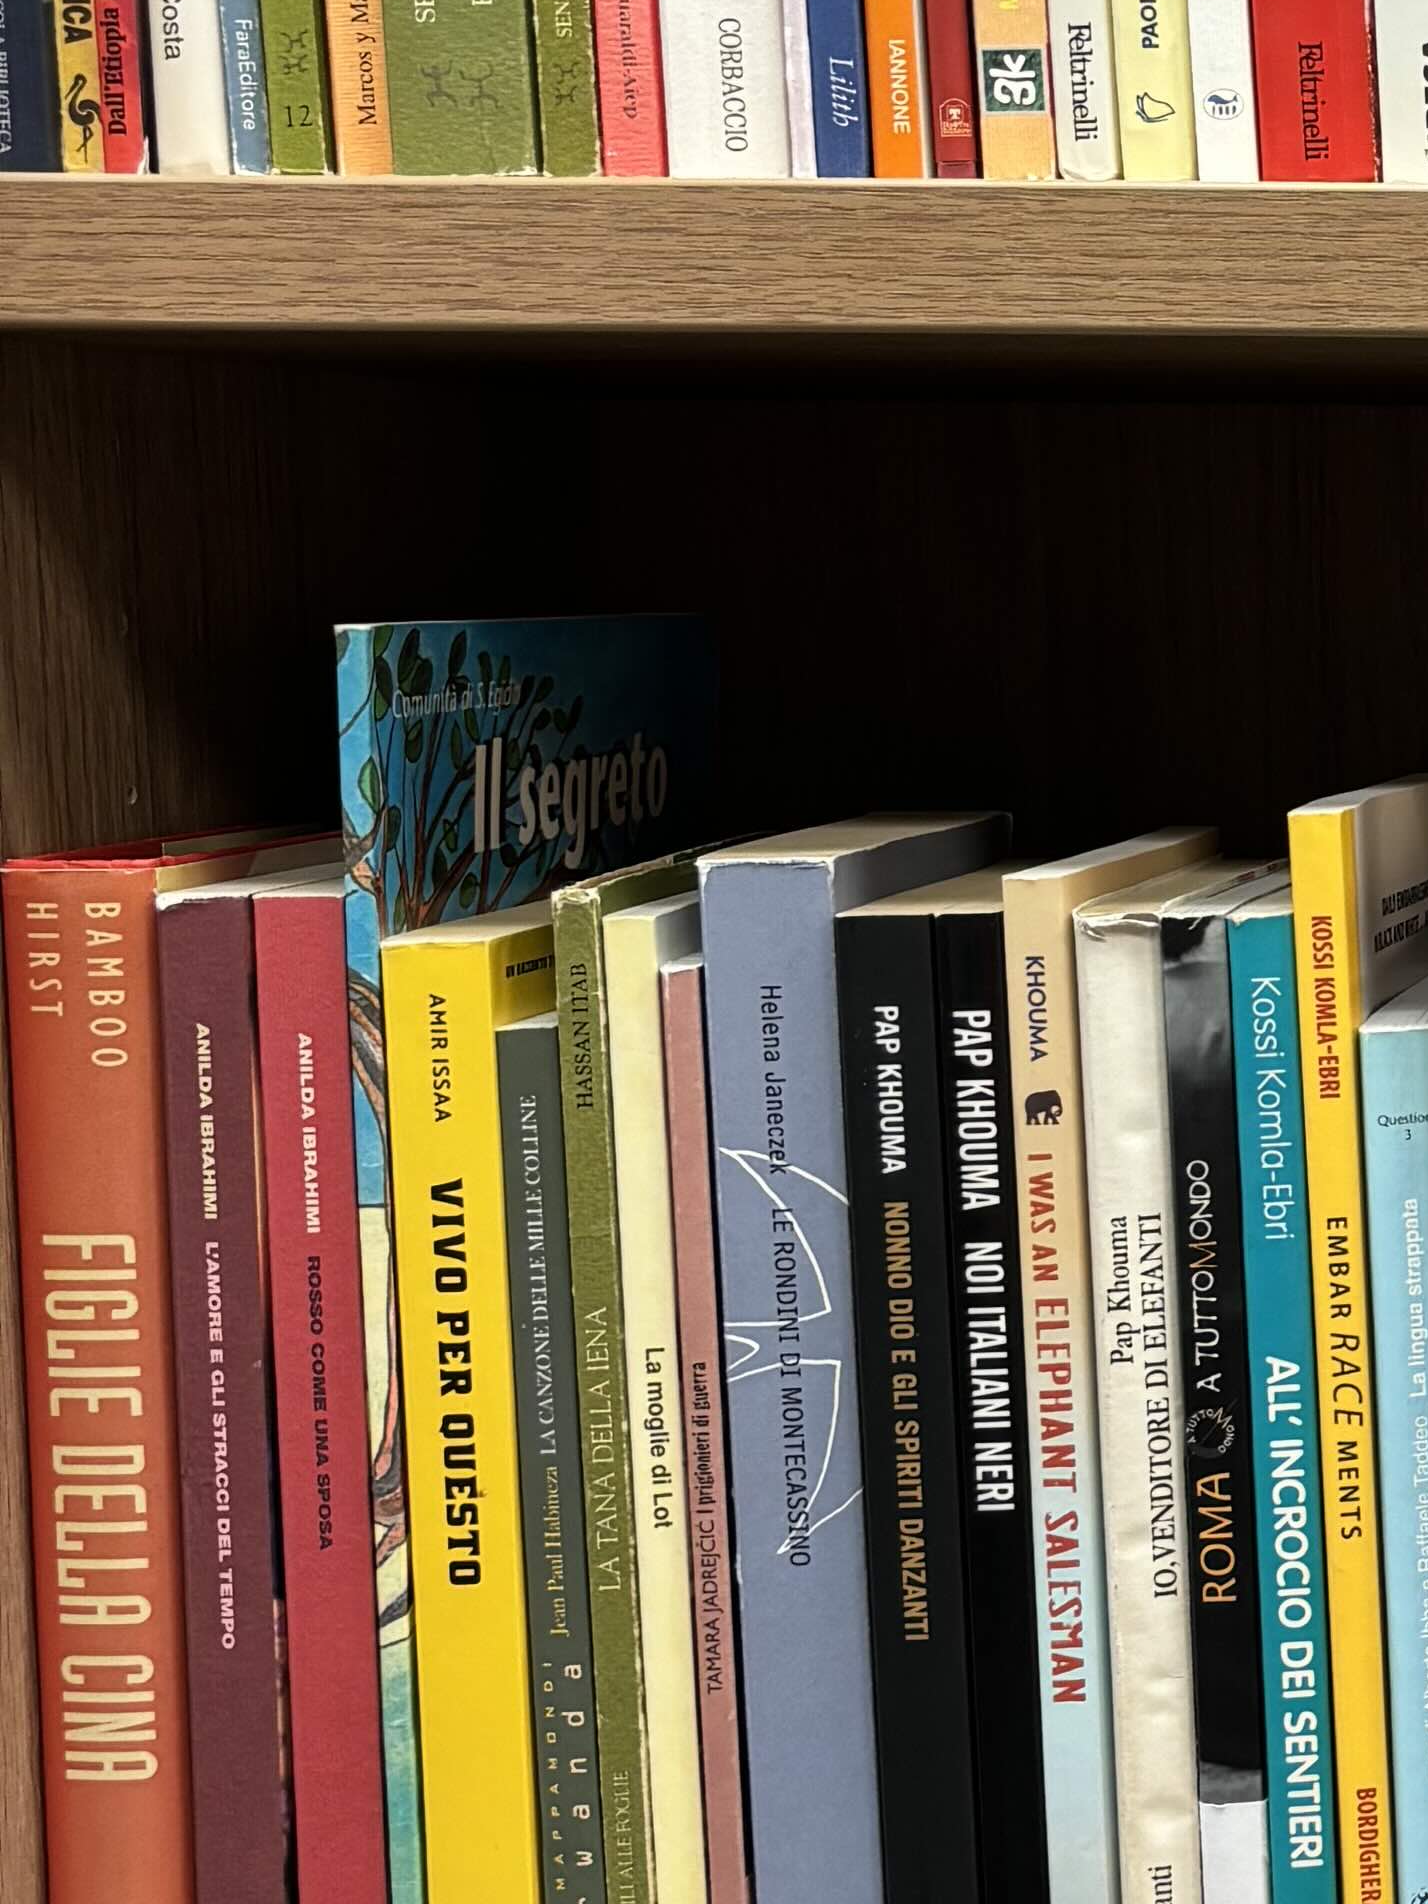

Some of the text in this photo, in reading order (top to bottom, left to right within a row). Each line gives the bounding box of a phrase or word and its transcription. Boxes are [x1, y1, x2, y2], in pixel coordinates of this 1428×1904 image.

[718, 18, 748, 152] CORBACCIO
[429, 994, 452, 1122] AMIR ISSAA
[1251, 977, 1285, 1057] Kossi
[431, 1178, 479, 1585] VIVO PER QUESTO
[965, 1242, 1015, 1511] NOI ITALIANI NERI
[43, 1235, 158, 1781] FIGLIE DELLA CINA
[1270, 1439, 1312, 1628] INCROCIO
[1280, 1641, 1316, 1698] DEI
[1284, 1711, 1323, 1868] SENTIERI
